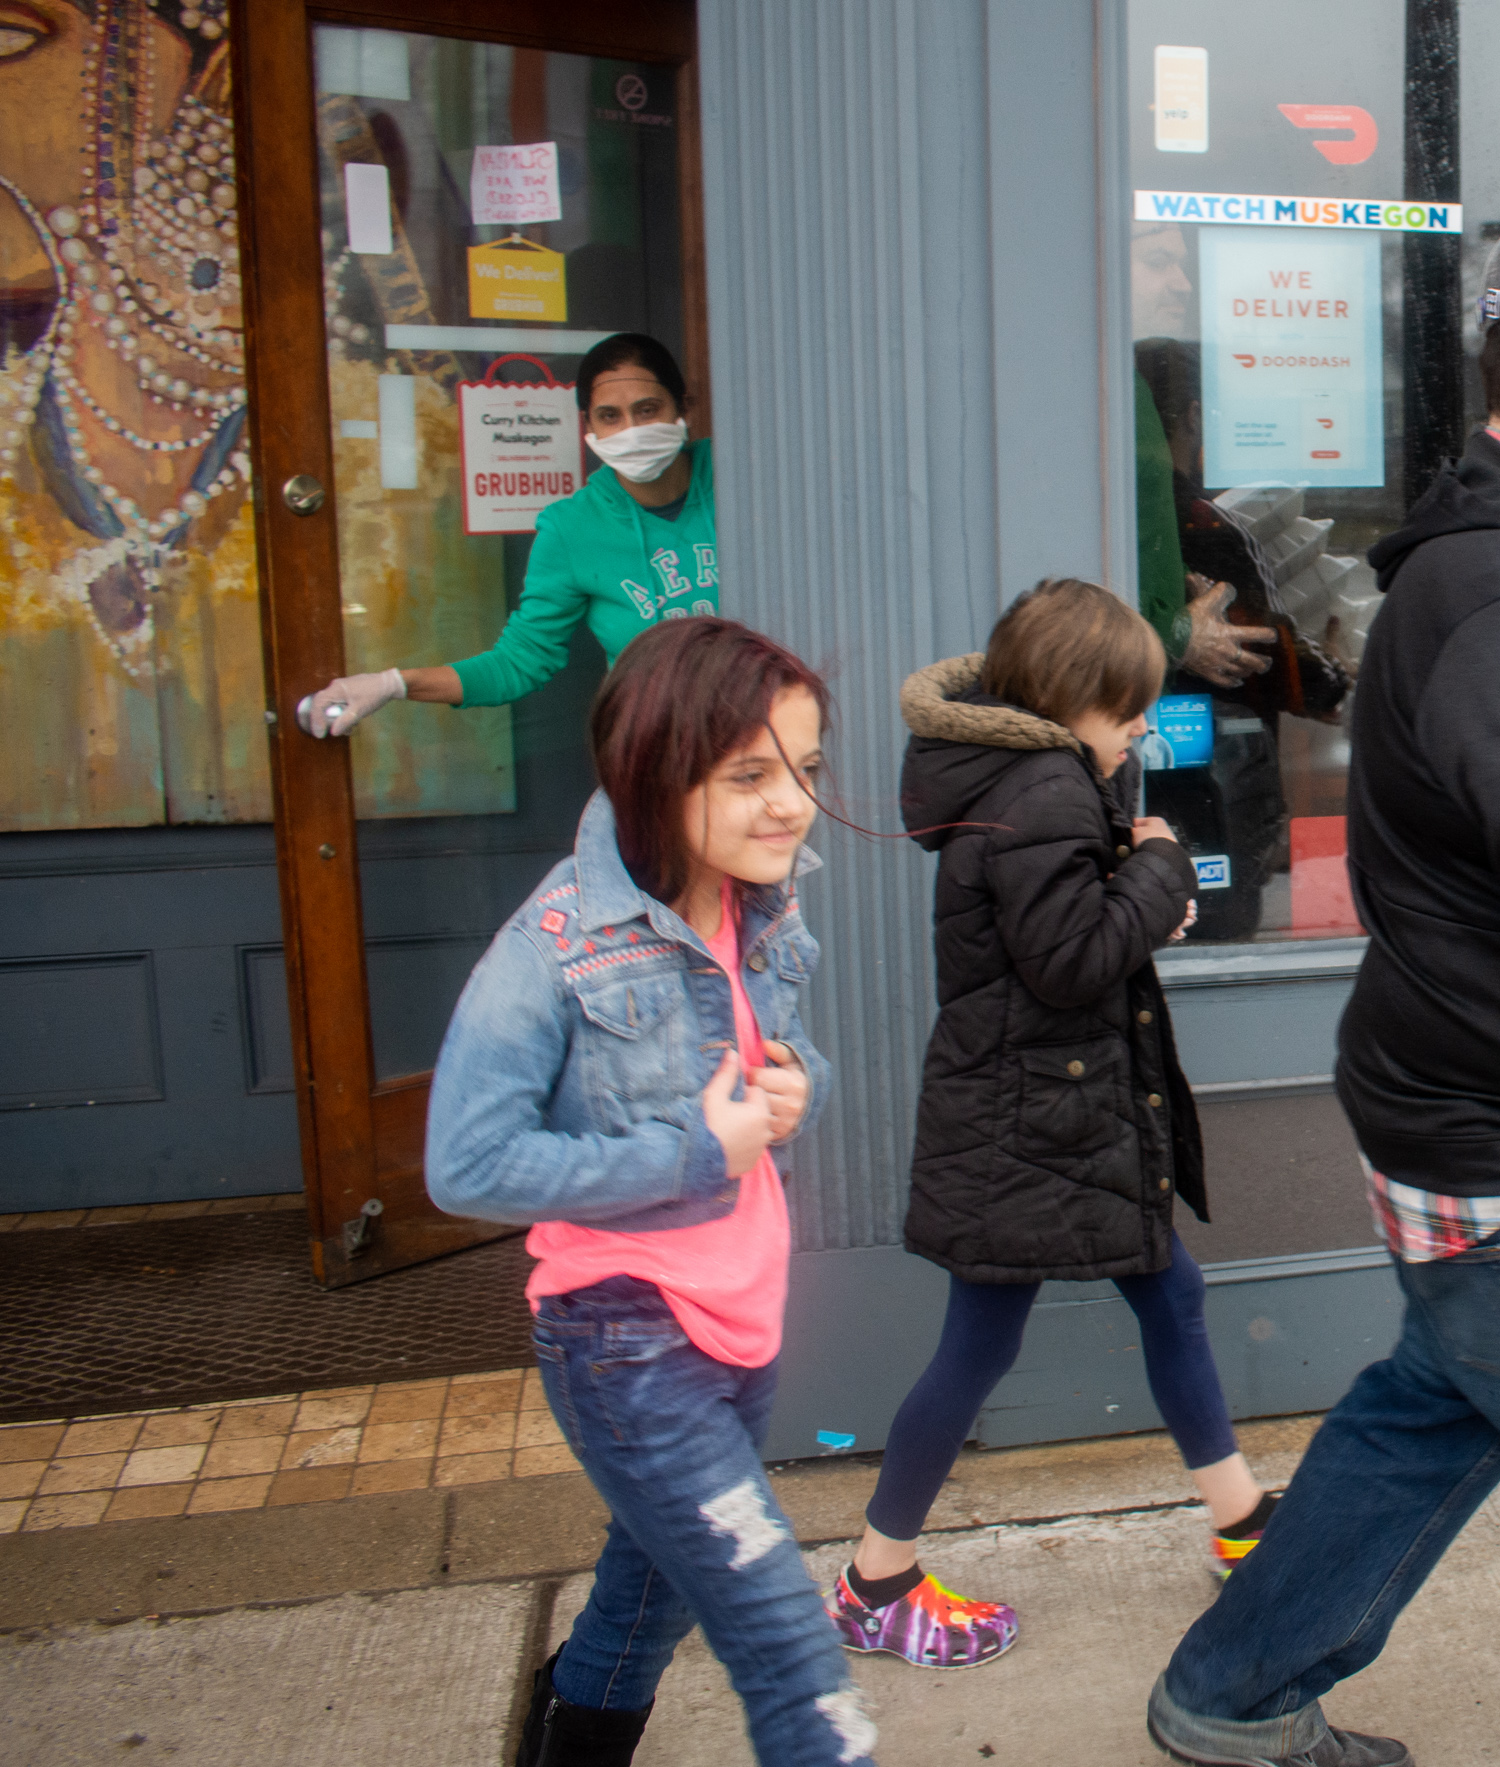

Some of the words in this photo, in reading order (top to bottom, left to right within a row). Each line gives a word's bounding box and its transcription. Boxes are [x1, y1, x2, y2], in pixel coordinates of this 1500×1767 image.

[1152, 194, 1265, 221] WATCH
[1274, 200, 1449, 229] MUSKEGON
[474, 262, 500, 279] We
[1269, 271, 1313, 289] WE
[1233, 298, 1349, 319] DELIVER
[1262, 355, 1351, 368] DOORDASH
[480, 413, 514, 428] Curry
[517, 413, 562, 425] Kitchen
[492, 432, 553, 446] Muskegon
[474, 471, 575, 497] GRUBHUB
[1159, 701, 1207, 713] LocalEats
[1198, 865, 1224, 880] ADT
